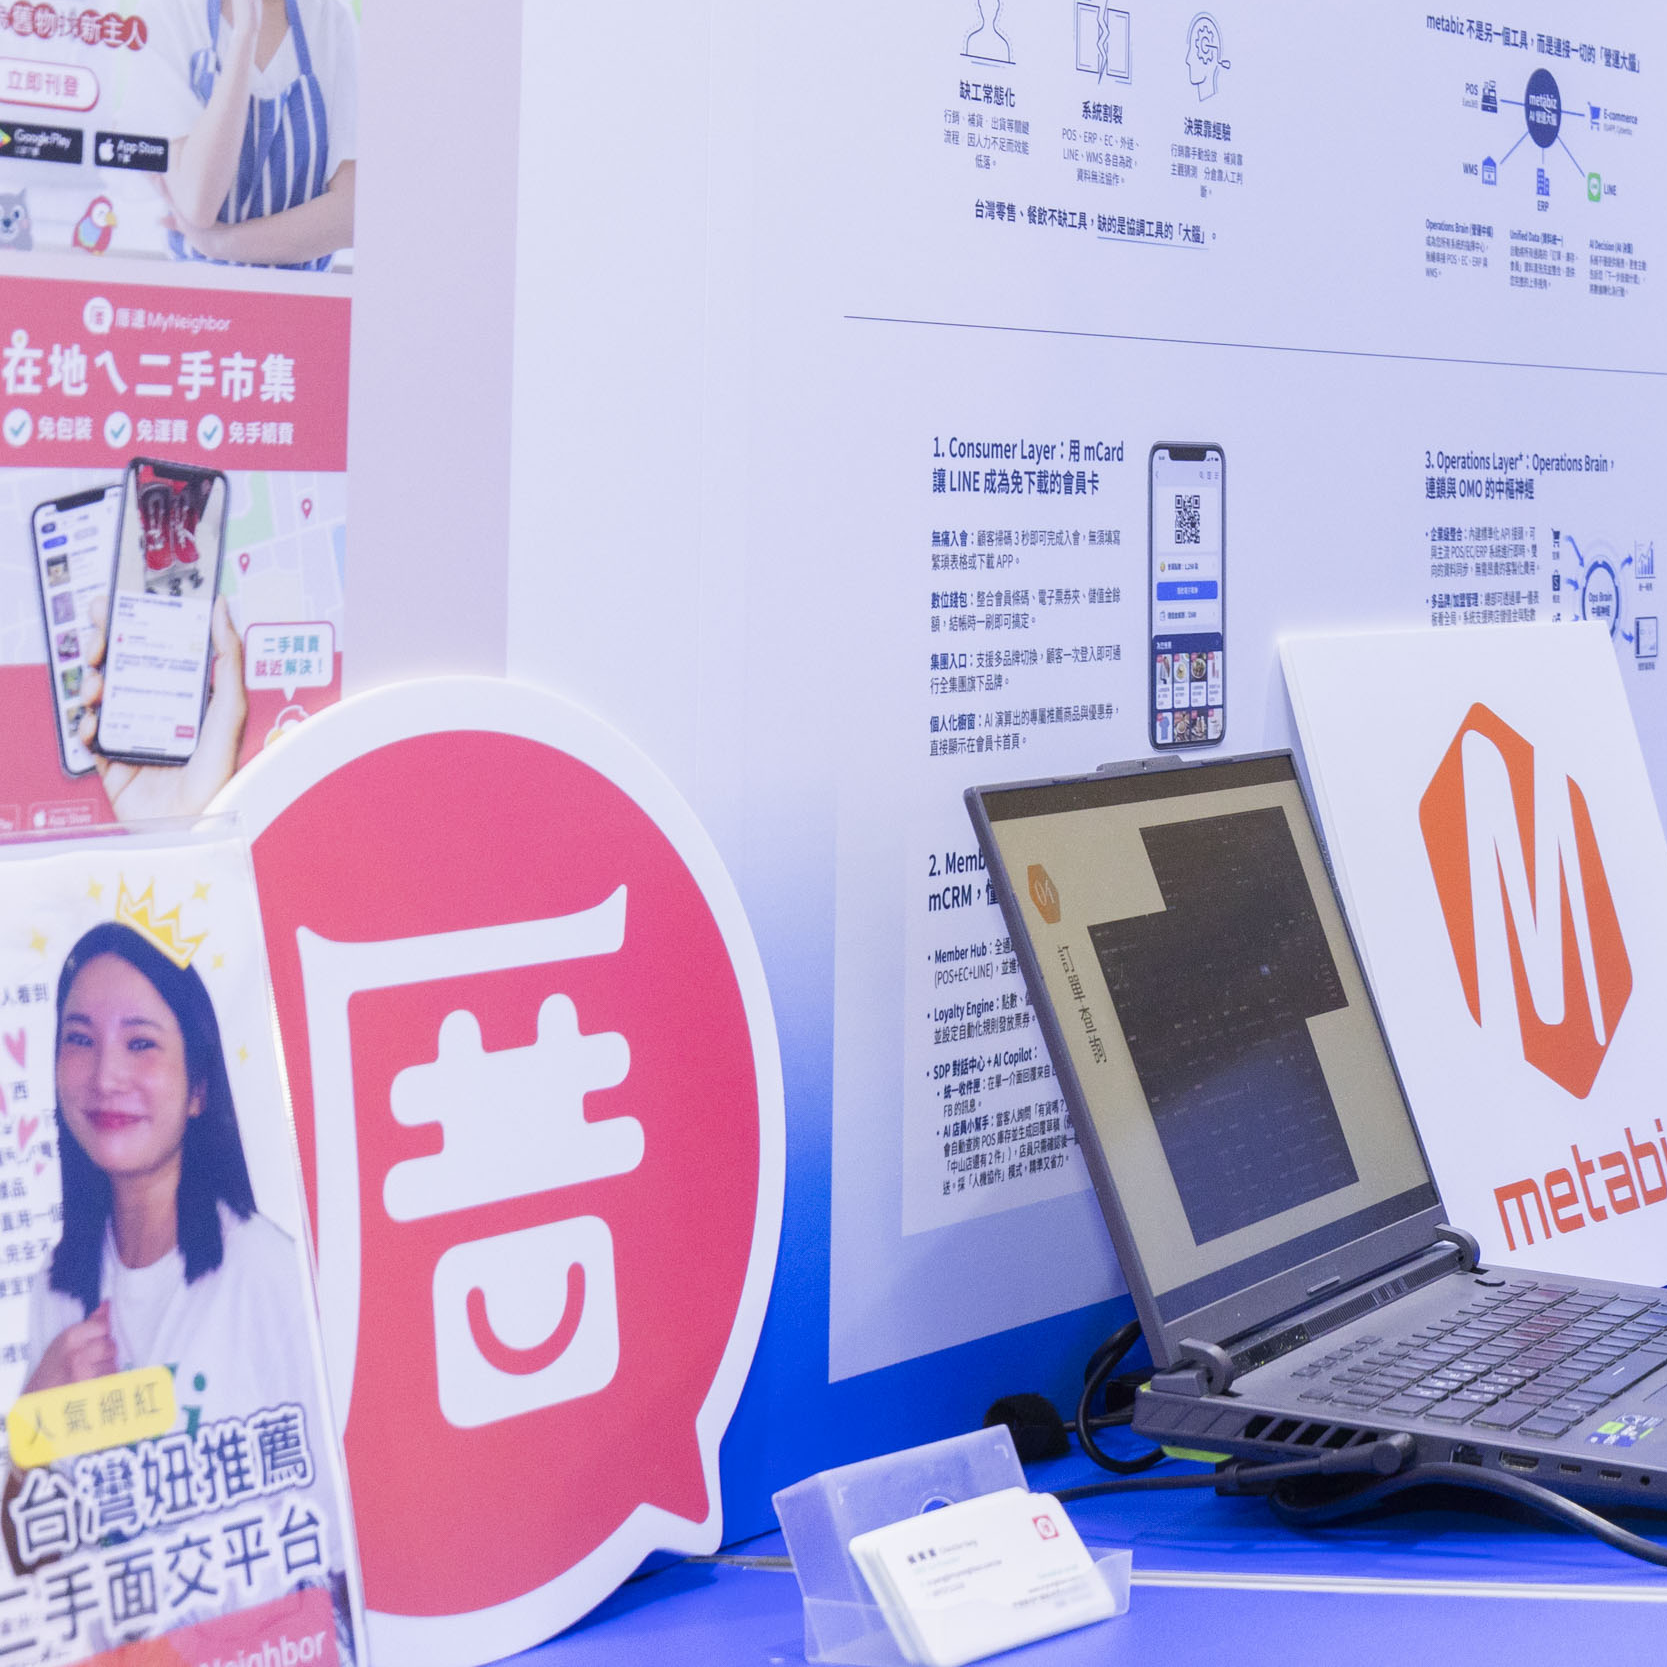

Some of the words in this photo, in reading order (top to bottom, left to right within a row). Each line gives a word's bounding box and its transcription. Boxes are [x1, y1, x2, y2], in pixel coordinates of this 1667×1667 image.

[933, 437, 945, 458] 1.
[949, 437, 1018, 460] Consumer
[1084, 441, 1123, 462] mCard
[933, 468, 946, 493] 讓
[950, 471, 980, 492] LINE
[984, 469, 1099, 495] 成為免下載的會員卡
